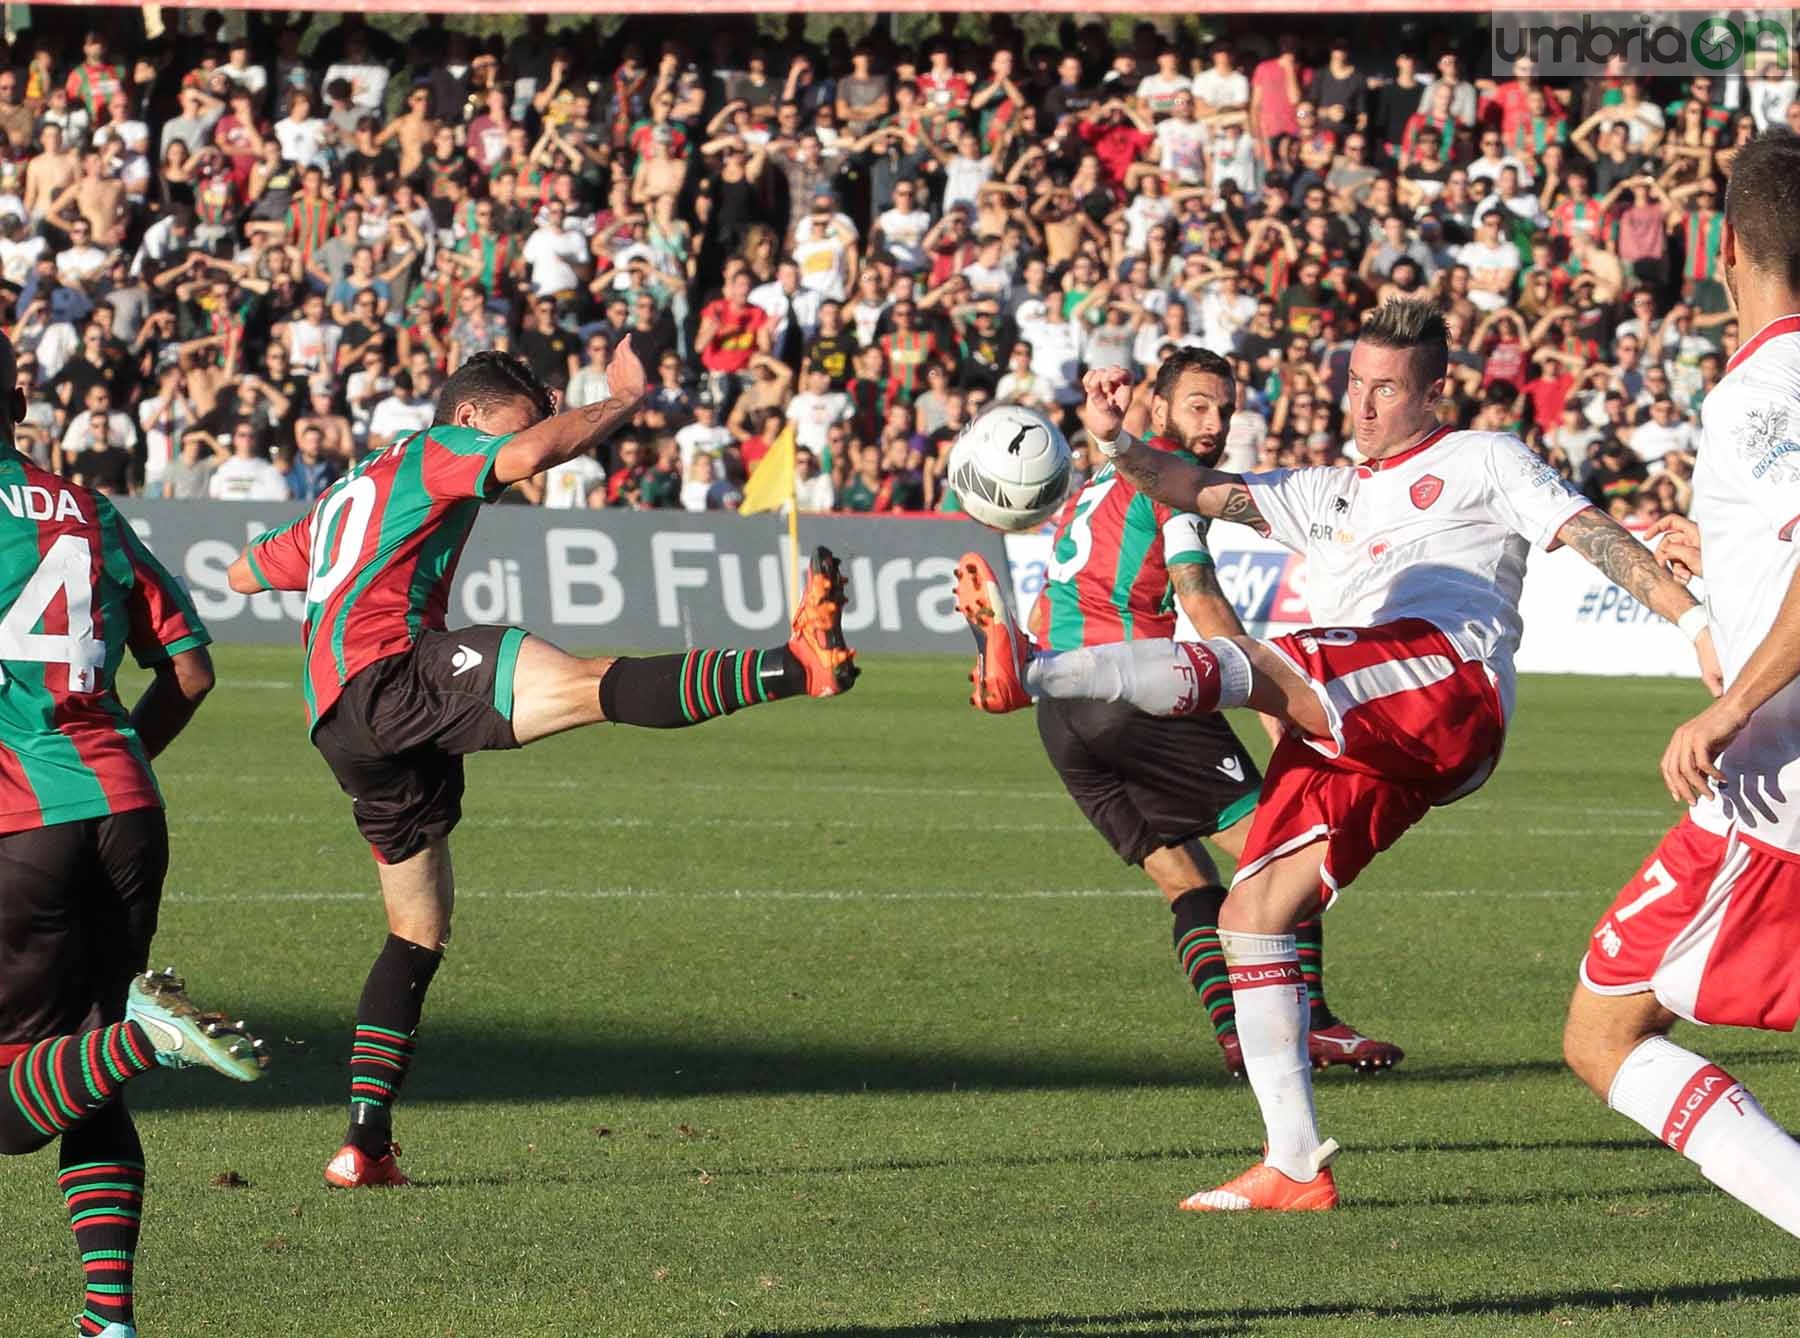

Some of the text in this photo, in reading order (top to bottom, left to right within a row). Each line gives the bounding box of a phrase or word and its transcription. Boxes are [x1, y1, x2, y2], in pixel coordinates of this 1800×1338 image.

[462, 558, 523, 624] di
[546, 528, 625, 626] B
[1614, 859, 1678, 923] 7
